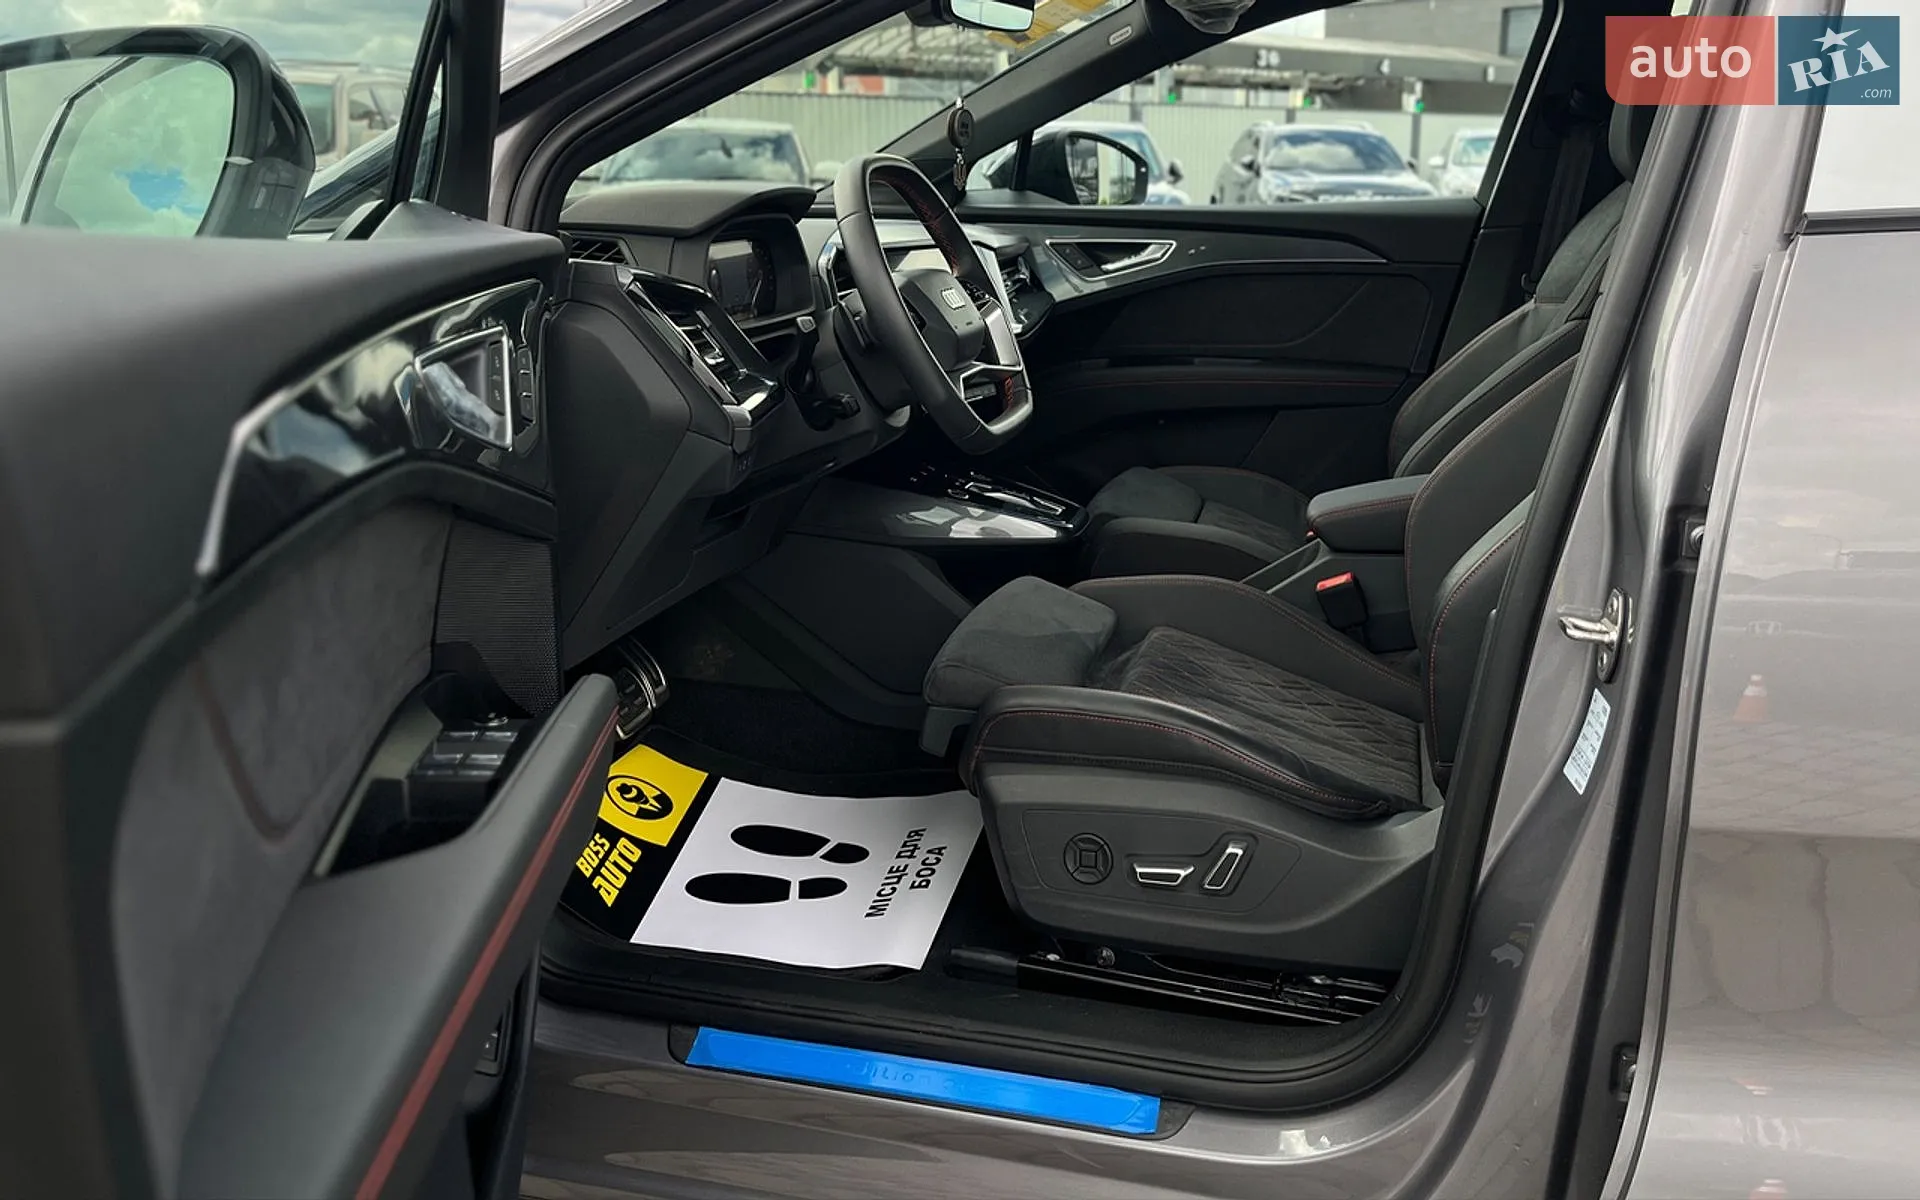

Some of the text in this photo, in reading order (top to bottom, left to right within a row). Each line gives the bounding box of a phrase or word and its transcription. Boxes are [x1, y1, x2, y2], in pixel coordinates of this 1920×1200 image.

[576, 833, 610, 878] BOSS
[592, 837, 642, 907] AUTO
[864, 828, 928, 918] МІСЦЕ ДЛЯ
[909, 846, 947, 890] БОСА
